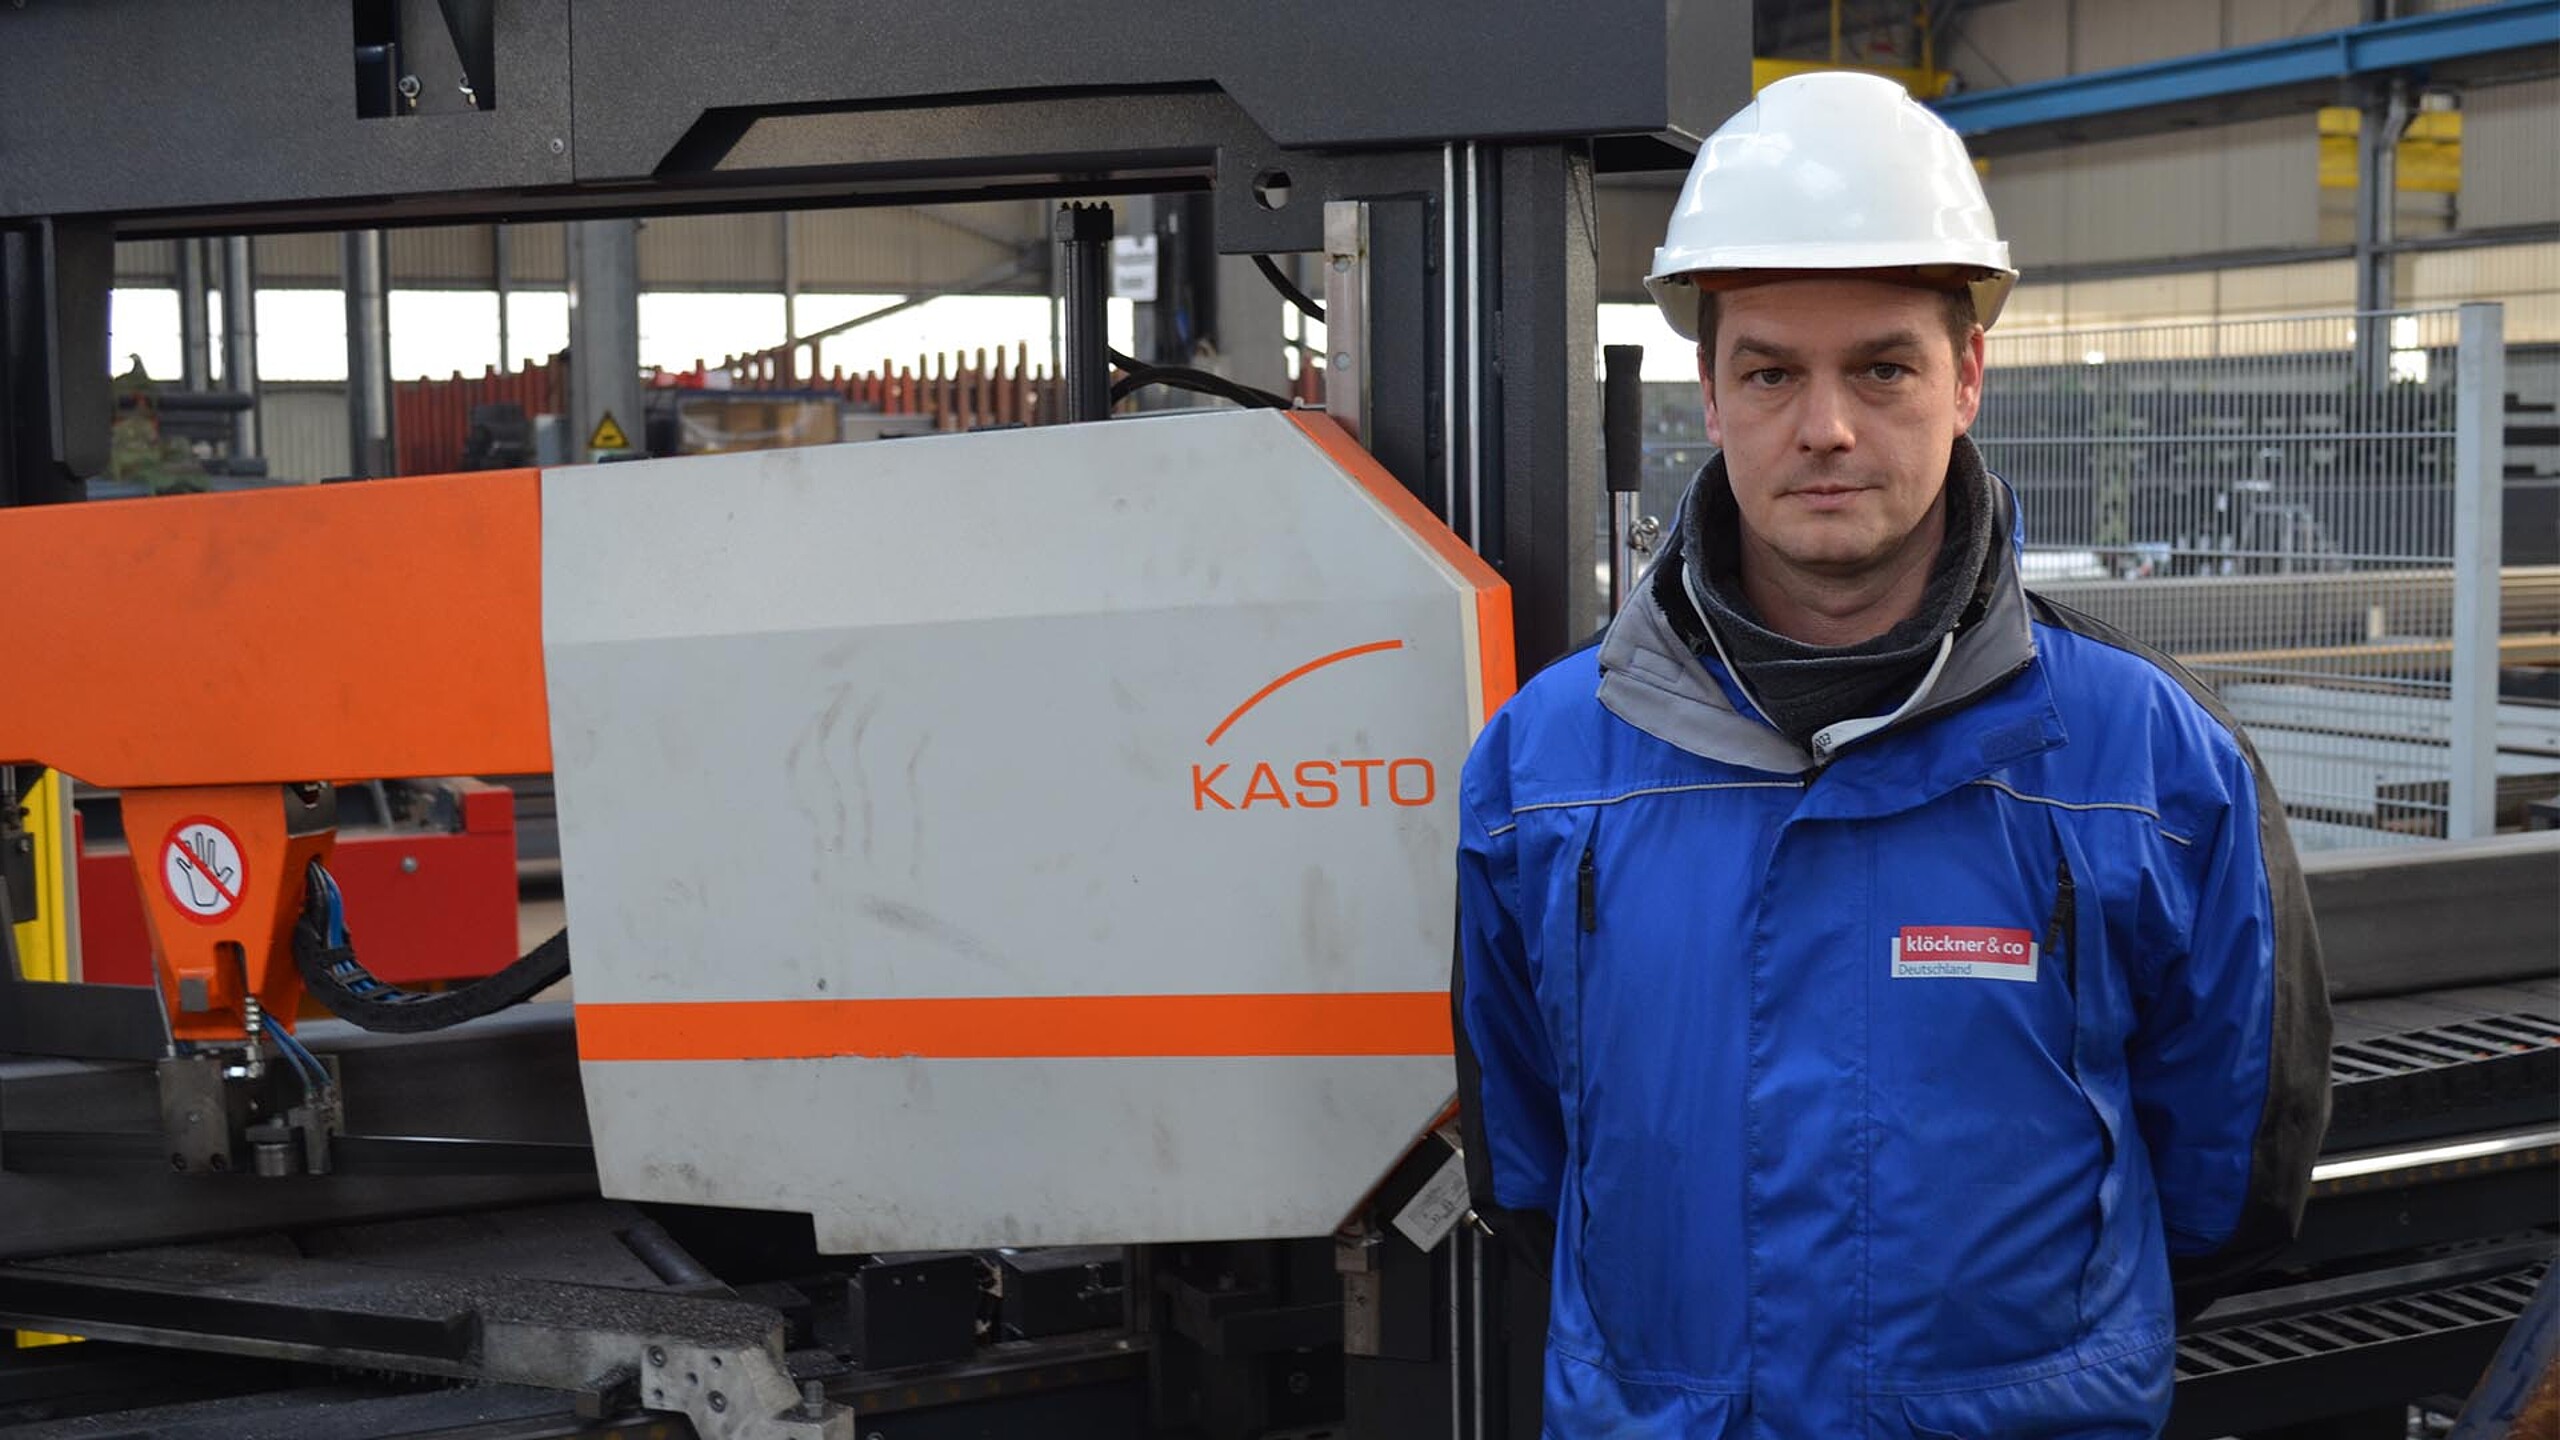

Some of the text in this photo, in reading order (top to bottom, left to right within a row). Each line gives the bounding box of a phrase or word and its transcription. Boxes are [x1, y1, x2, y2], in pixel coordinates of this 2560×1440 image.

[1192, 758, 1435, 811] KASTO
[1906, 935, 2024, 955] klöckner & co
[1899, 963, 1972, 975] Deutschland
